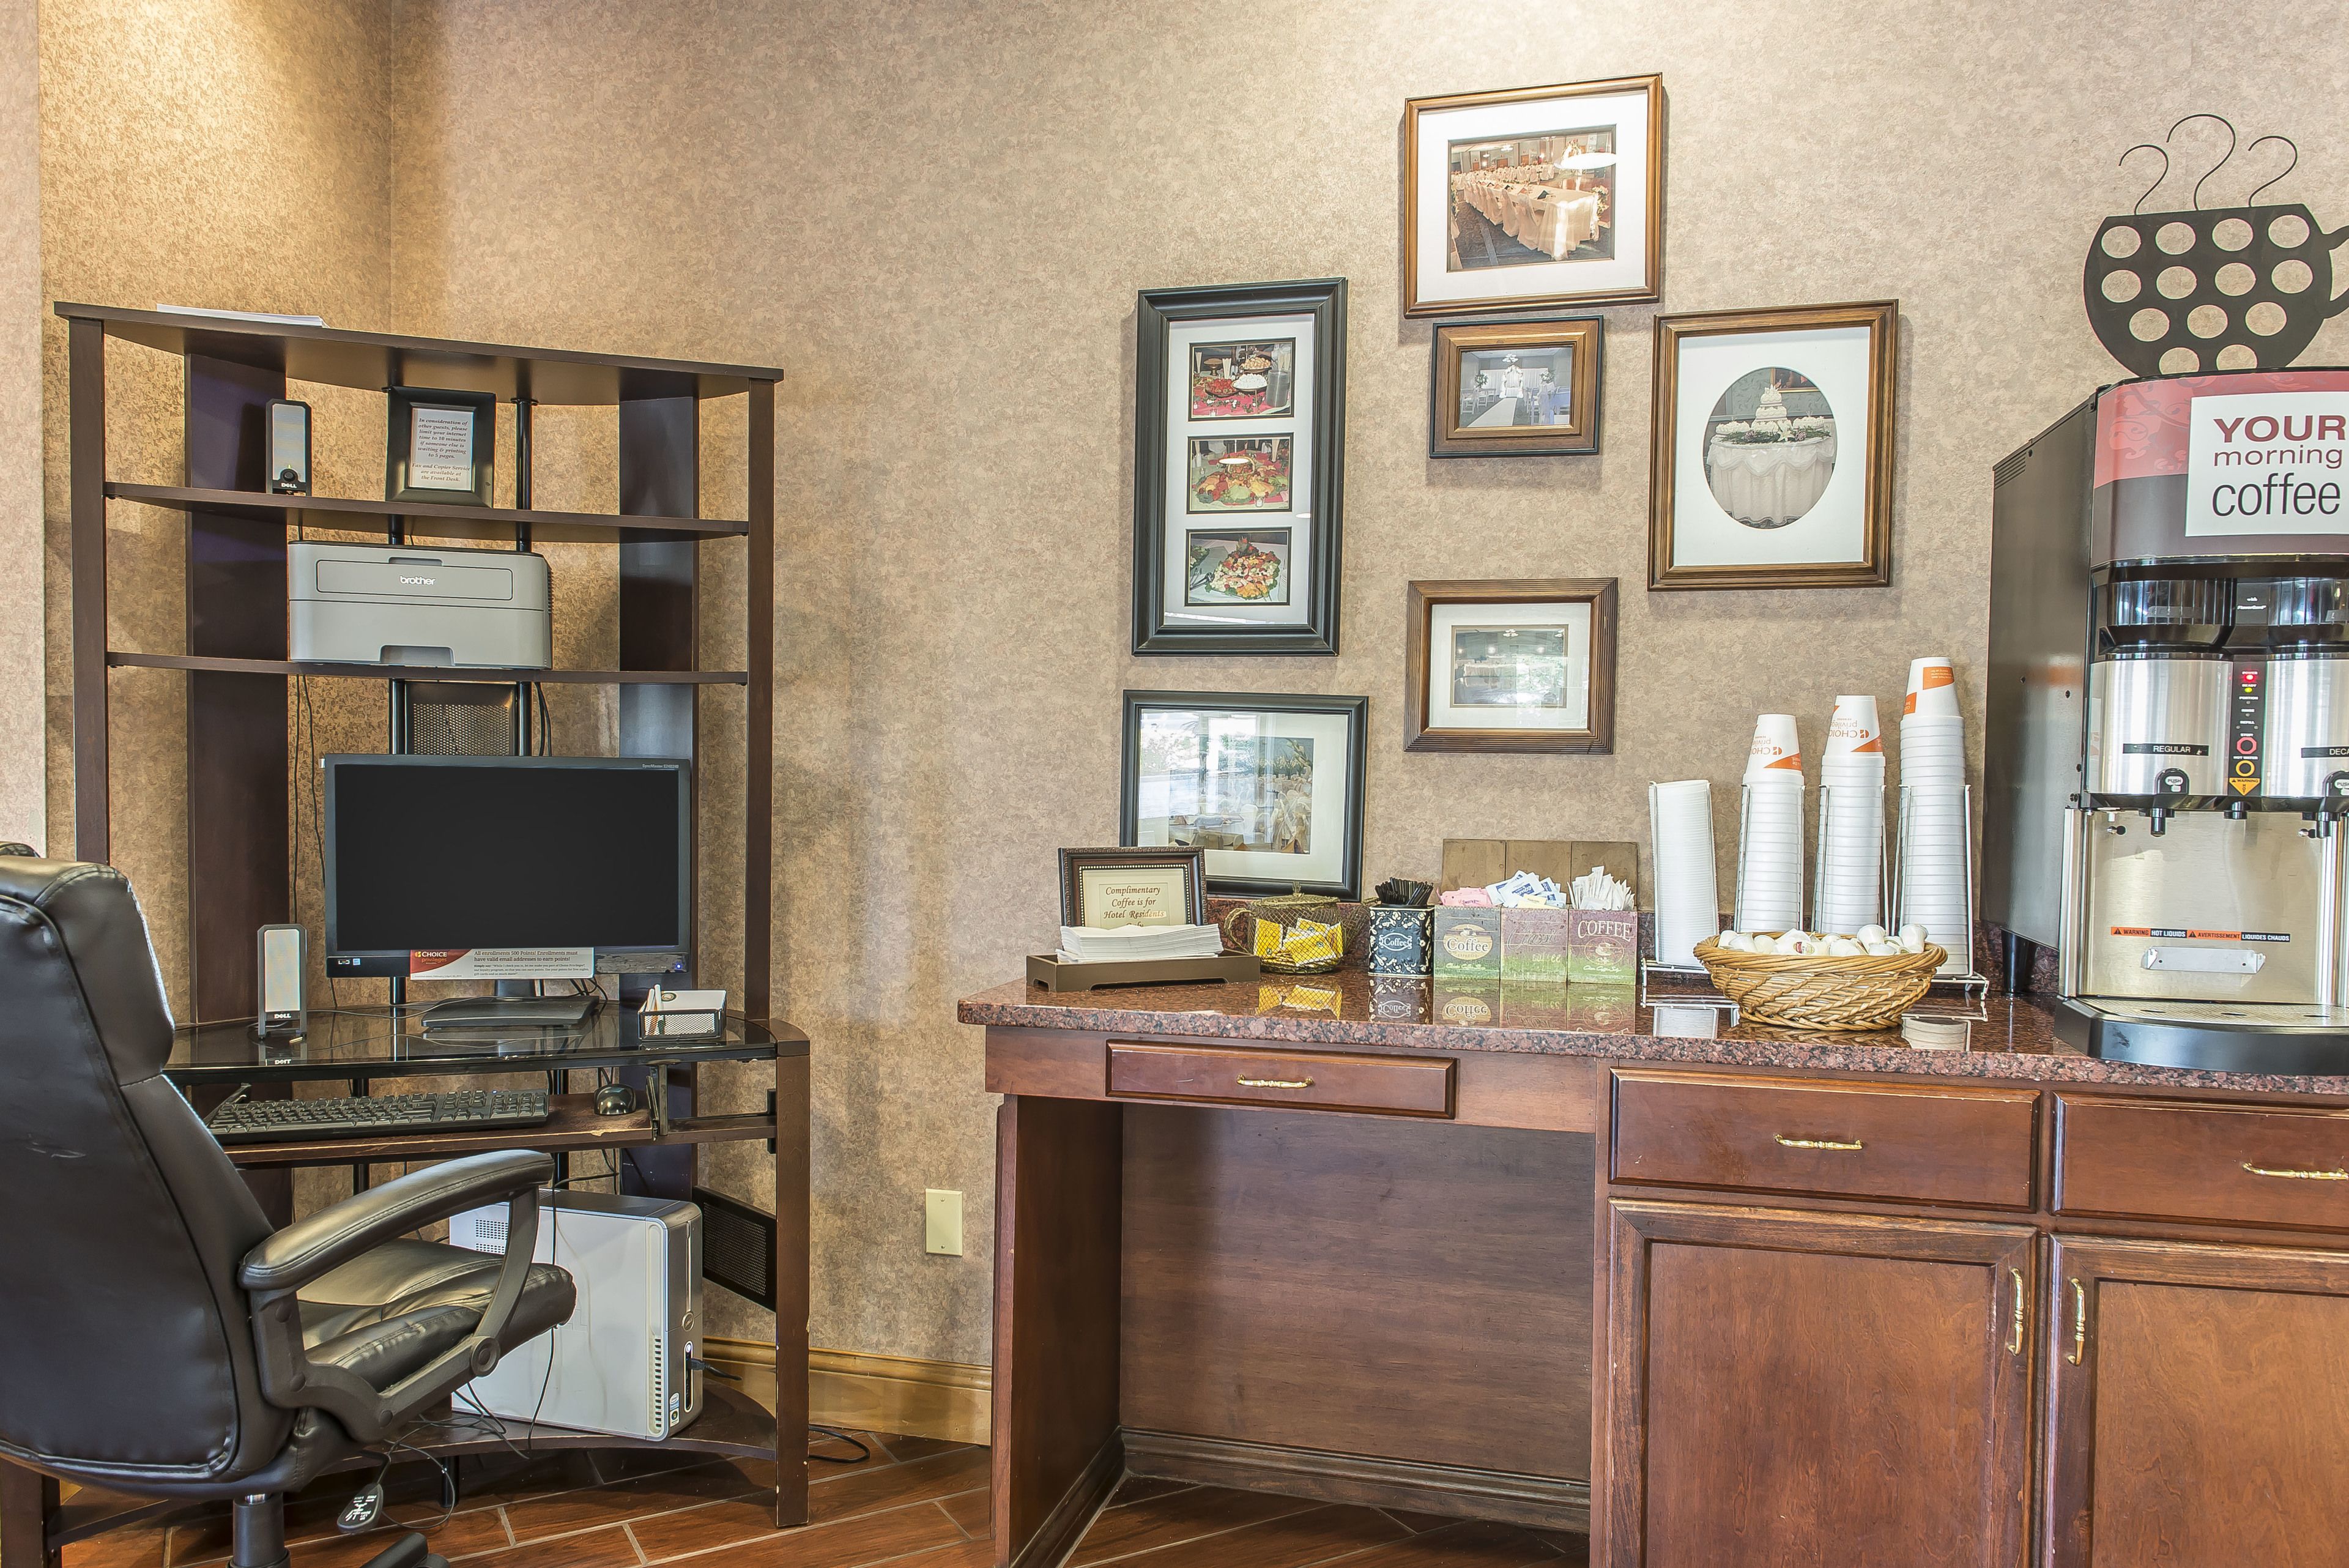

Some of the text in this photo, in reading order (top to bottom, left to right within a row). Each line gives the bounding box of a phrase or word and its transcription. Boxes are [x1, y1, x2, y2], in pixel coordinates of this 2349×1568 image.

[2213, 415, 2346, 443] YOUR
[2214, 445, 2342, 469] morning
[2213, 472, 2340, 516] coffee
[400, 576, 436, 585] brother
[1105, 886, 1160, 896] Complimentary
[1111, 897, 1135, 908] Coffee
[1143, 897, 1156, 908] for
[1104, 909, 1165, 919] Hotel Residents
[1578, 920, 1631, 942] COFFEE
[1384, 938, 1407, 946] Coffee
[1447, 938, 1489, 952] Coffee
